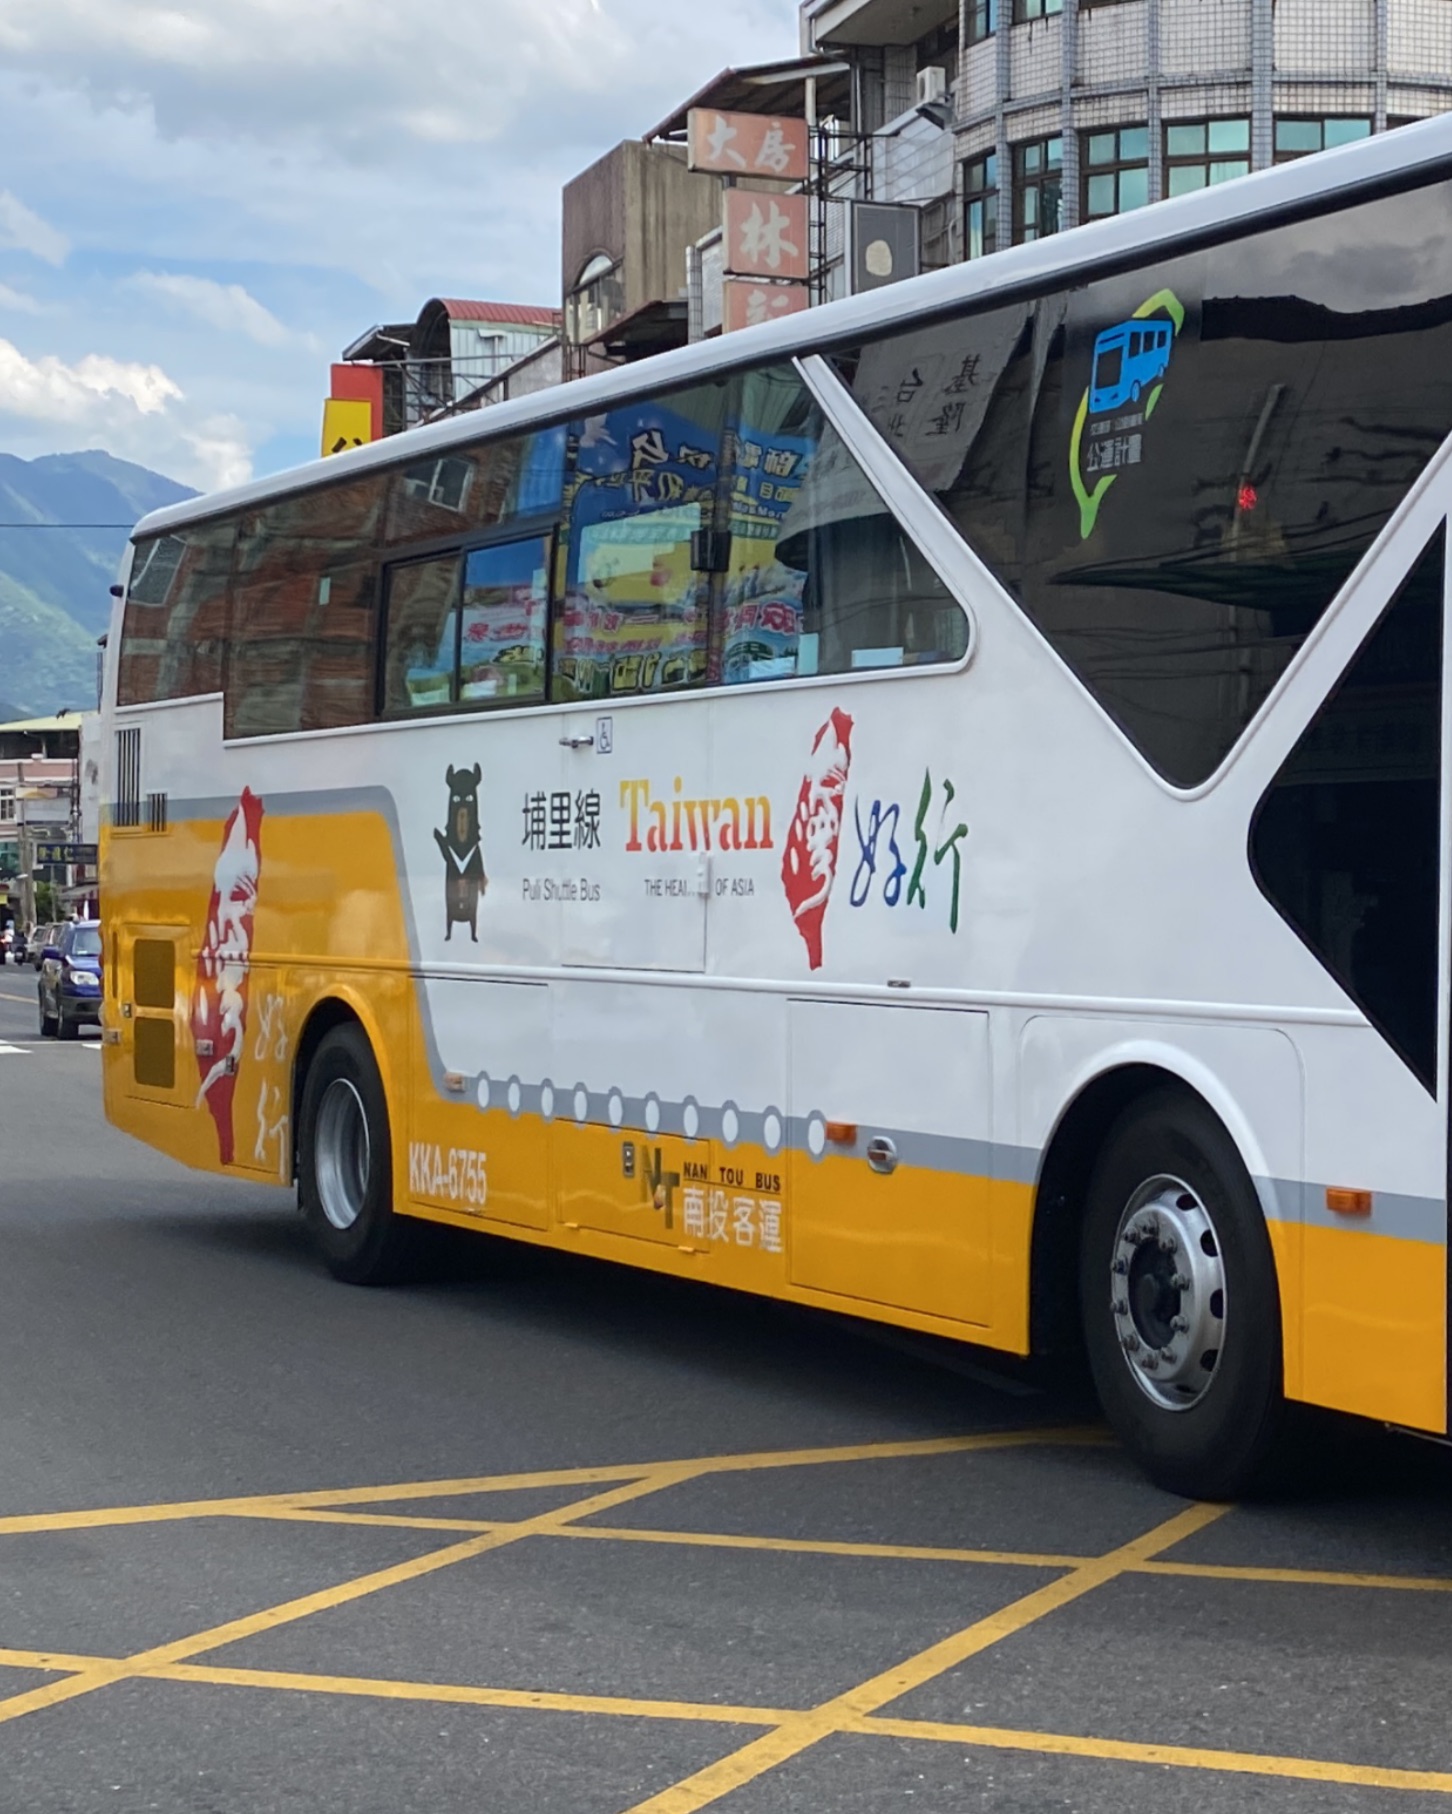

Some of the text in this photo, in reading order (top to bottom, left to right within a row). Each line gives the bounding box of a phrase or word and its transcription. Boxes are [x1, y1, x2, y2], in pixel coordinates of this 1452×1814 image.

[739, 200, 798, 269] 林
[522, 789, 601, 851] 埔里線
[619, 776, 774, 852] Taiwan
[522, 878, 600, 901] Puli Shuttle Bus
[644, 879, 662, 896] THE
[715, 878, 729, 896] OF
[731, 878, 754, 896] ASIA
[409, 1141, 487, 1205] KKA-6755
[684, 1162, 781, 1192] NAN TOU BUS
[683, 1185, 783, 1253] 南投客運
